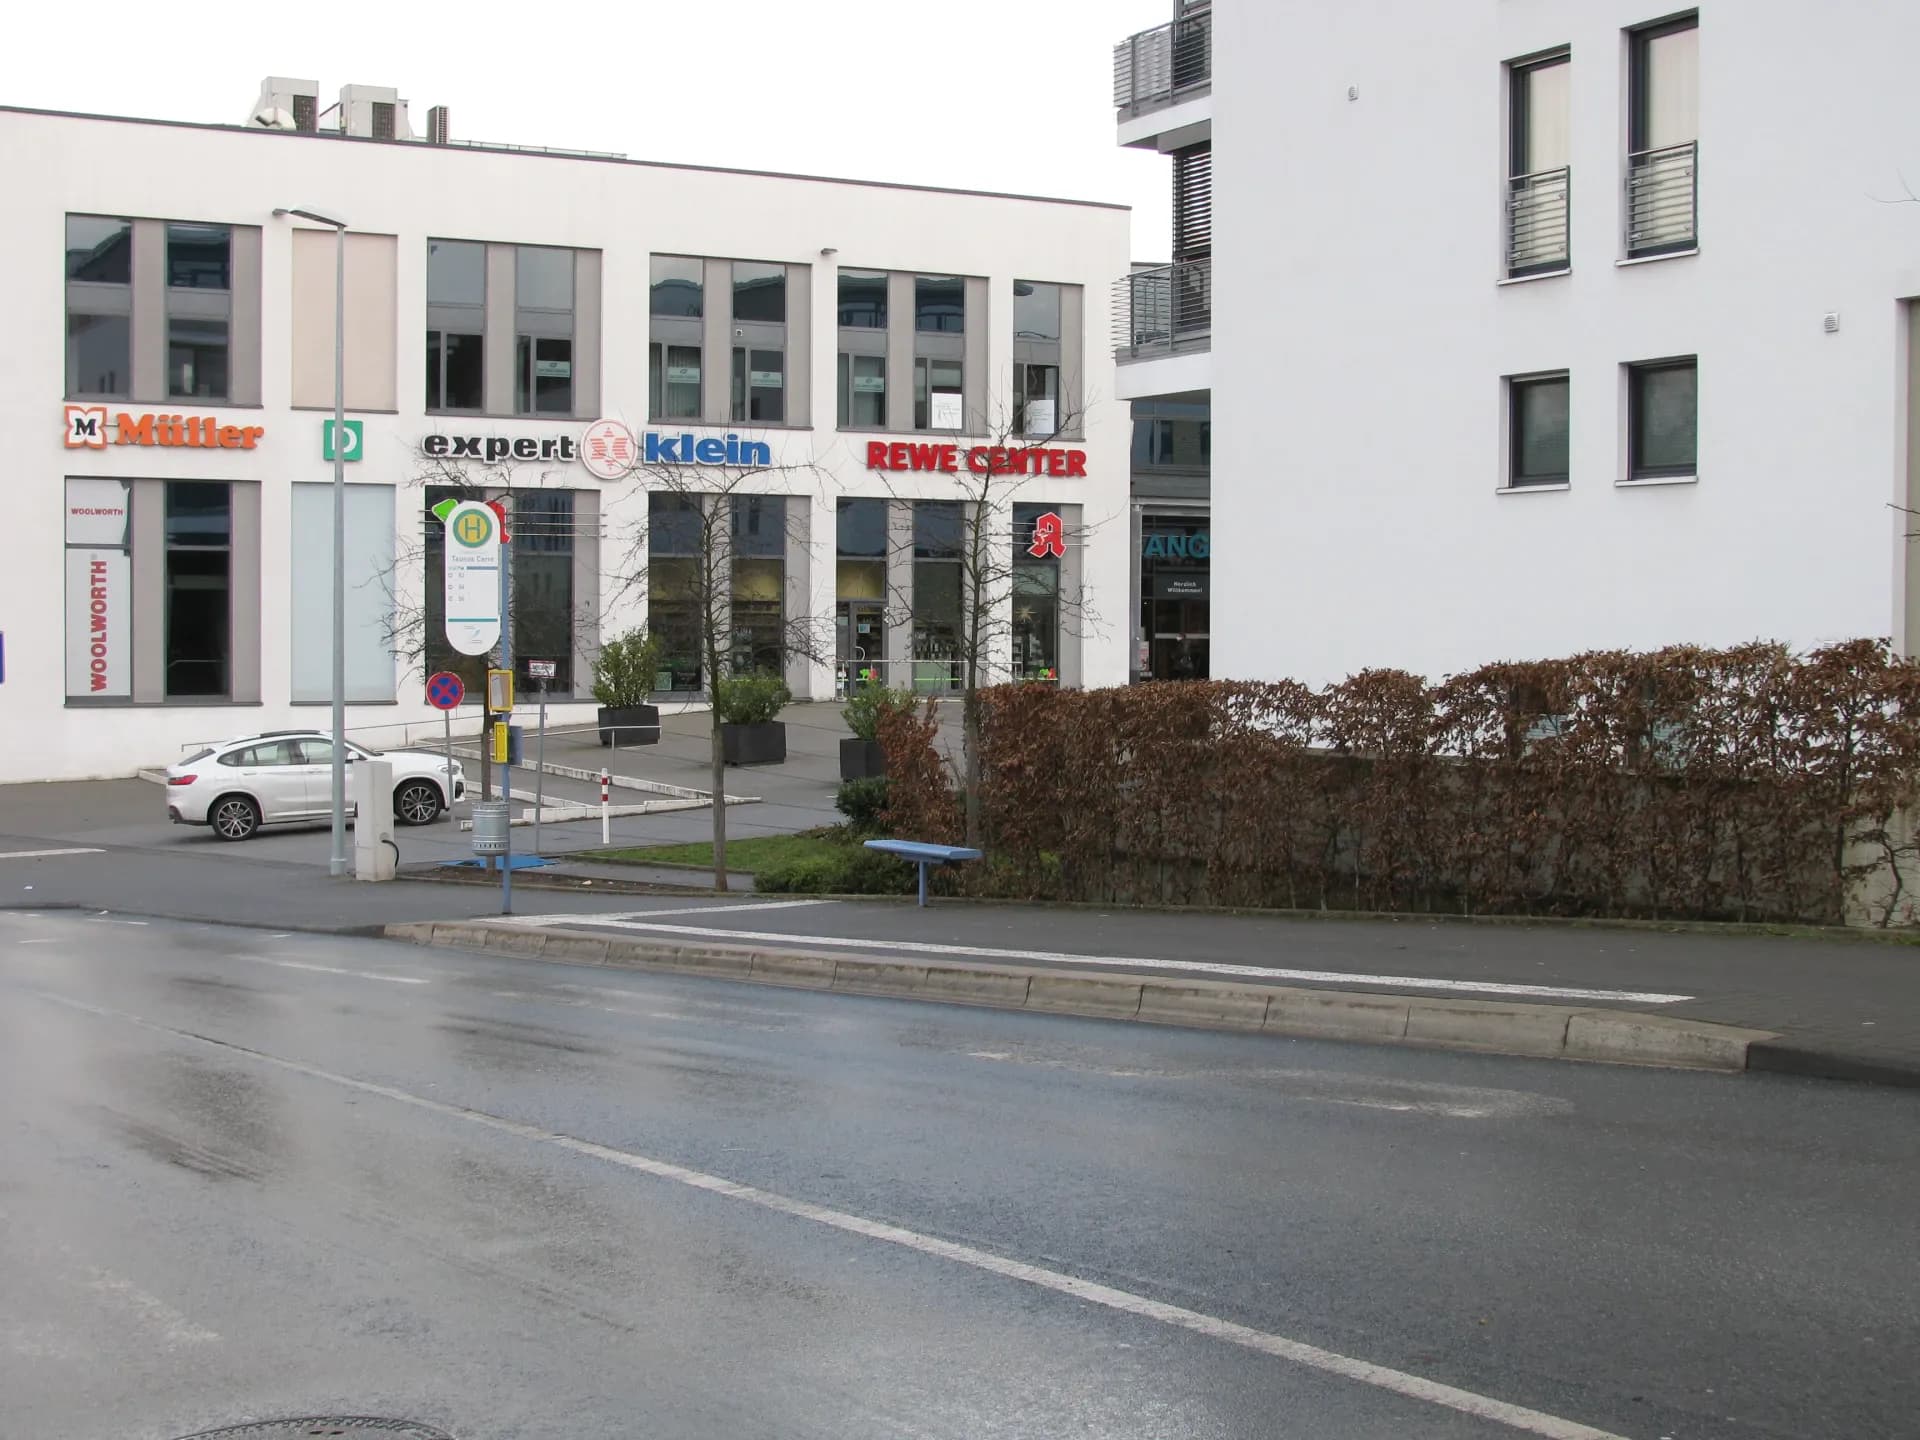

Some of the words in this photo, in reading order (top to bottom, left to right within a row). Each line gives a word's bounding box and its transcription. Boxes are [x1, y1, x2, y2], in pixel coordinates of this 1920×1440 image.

[75, 418, 97, 436] M
[115, 411, 265, 449] Müller
[424, 433, 574, 465] expert
[643, 432, 772, 465] klein
[867, 441, 958, 473] REWE
[968, 446, 1087, 478] CENTER
[71, 507, 124, 517] WOOLWORTH
[465, 518, 481, 539] H
[90, 560, 108, 692] WOOLWORTH
